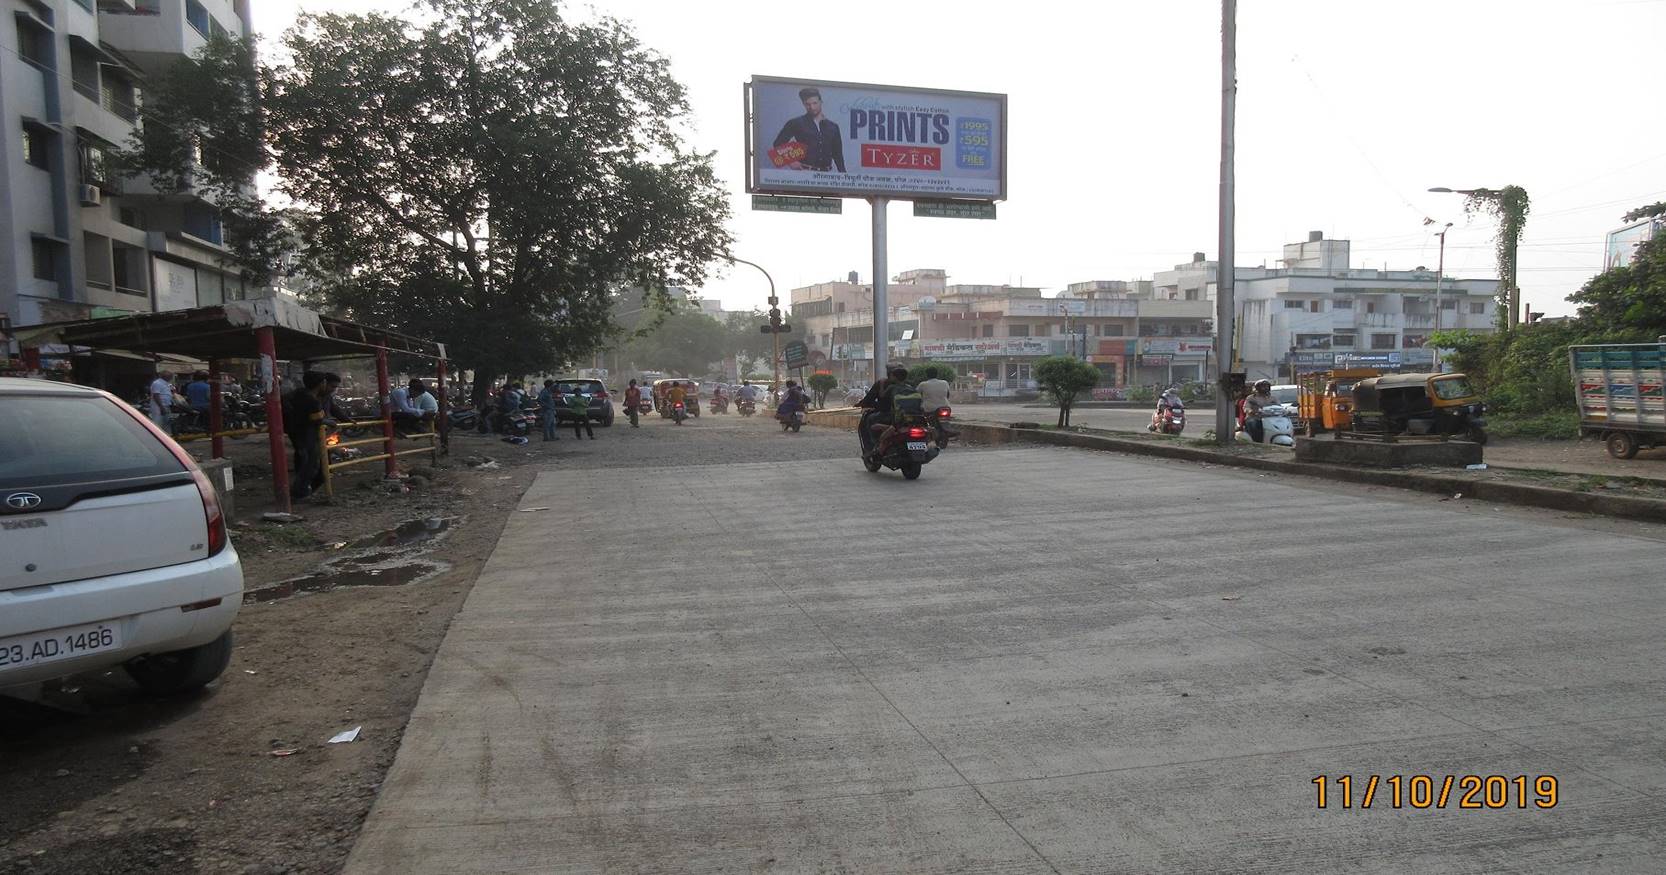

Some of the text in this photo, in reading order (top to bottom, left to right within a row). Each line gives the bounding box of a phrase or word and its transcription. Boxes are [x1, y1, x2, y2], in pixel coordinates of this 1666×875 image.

[849, 109, 950, 145] PRINTS
[867, 147, 935, 167] TYZER
[962, 154, 985, 165] FREE
